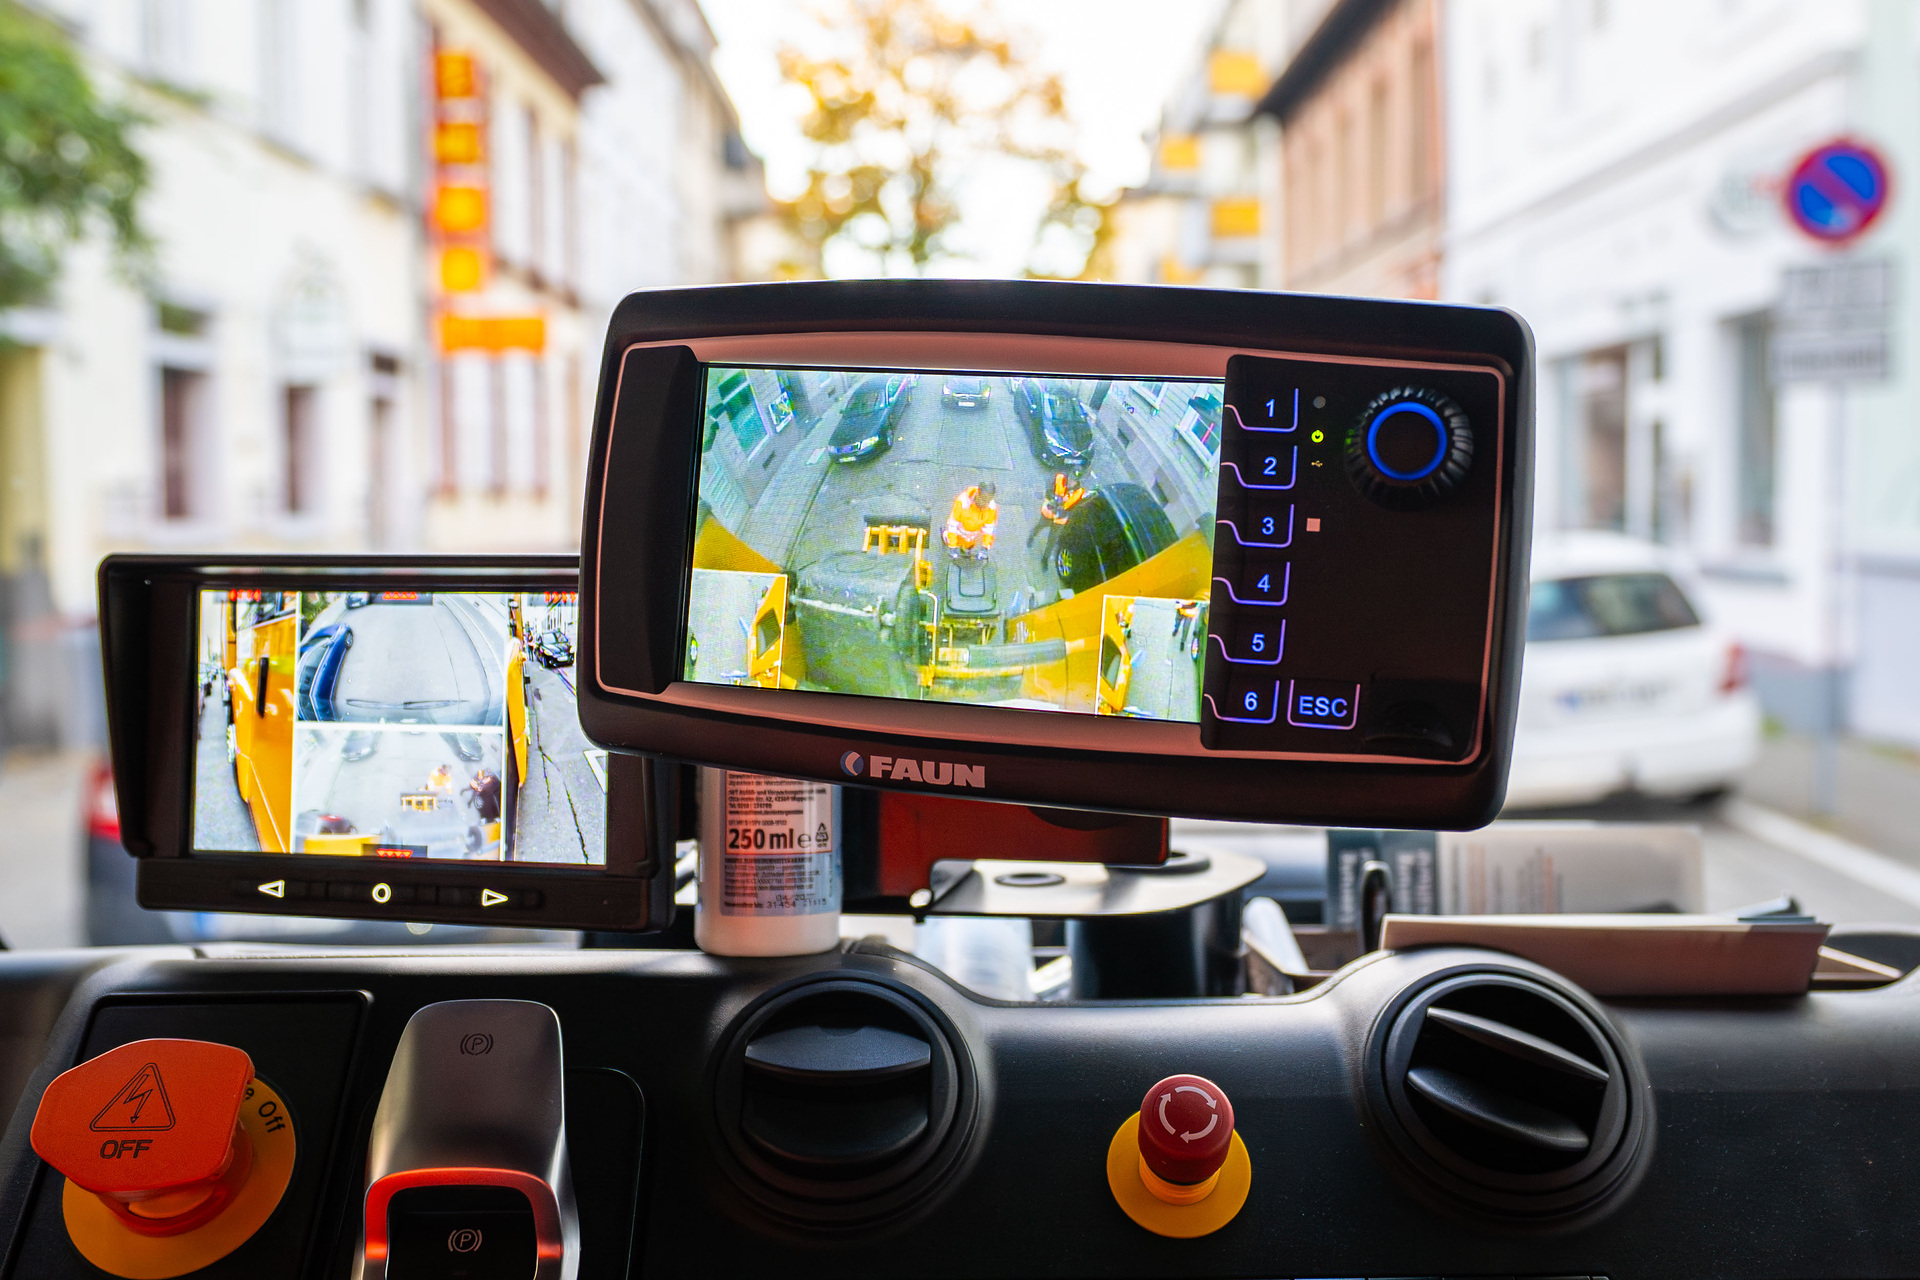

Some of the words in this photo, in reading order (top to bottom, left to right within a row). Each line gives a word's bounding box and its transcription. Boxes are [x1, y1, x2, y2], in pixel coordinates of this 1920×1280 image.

[1266, 399, 1276, 418] 1
[1263, 457, 1277, 475] 2
[1261, 517, 1275, 535] 3
[1257, 574, 1271, 592] 4
[1251, 634, 1265, 652] 5
[1244, 692, 1258, 710] 6
[1298, 695, 1348, 718] ESC
[870, 755, 985, 788] FAUN
[728, 828, 765, 849] 250
[769, 828, 794, 850] ml
[258, 1101, 285, 1132] Off
[99, 1139, 154, 1160] OFF
